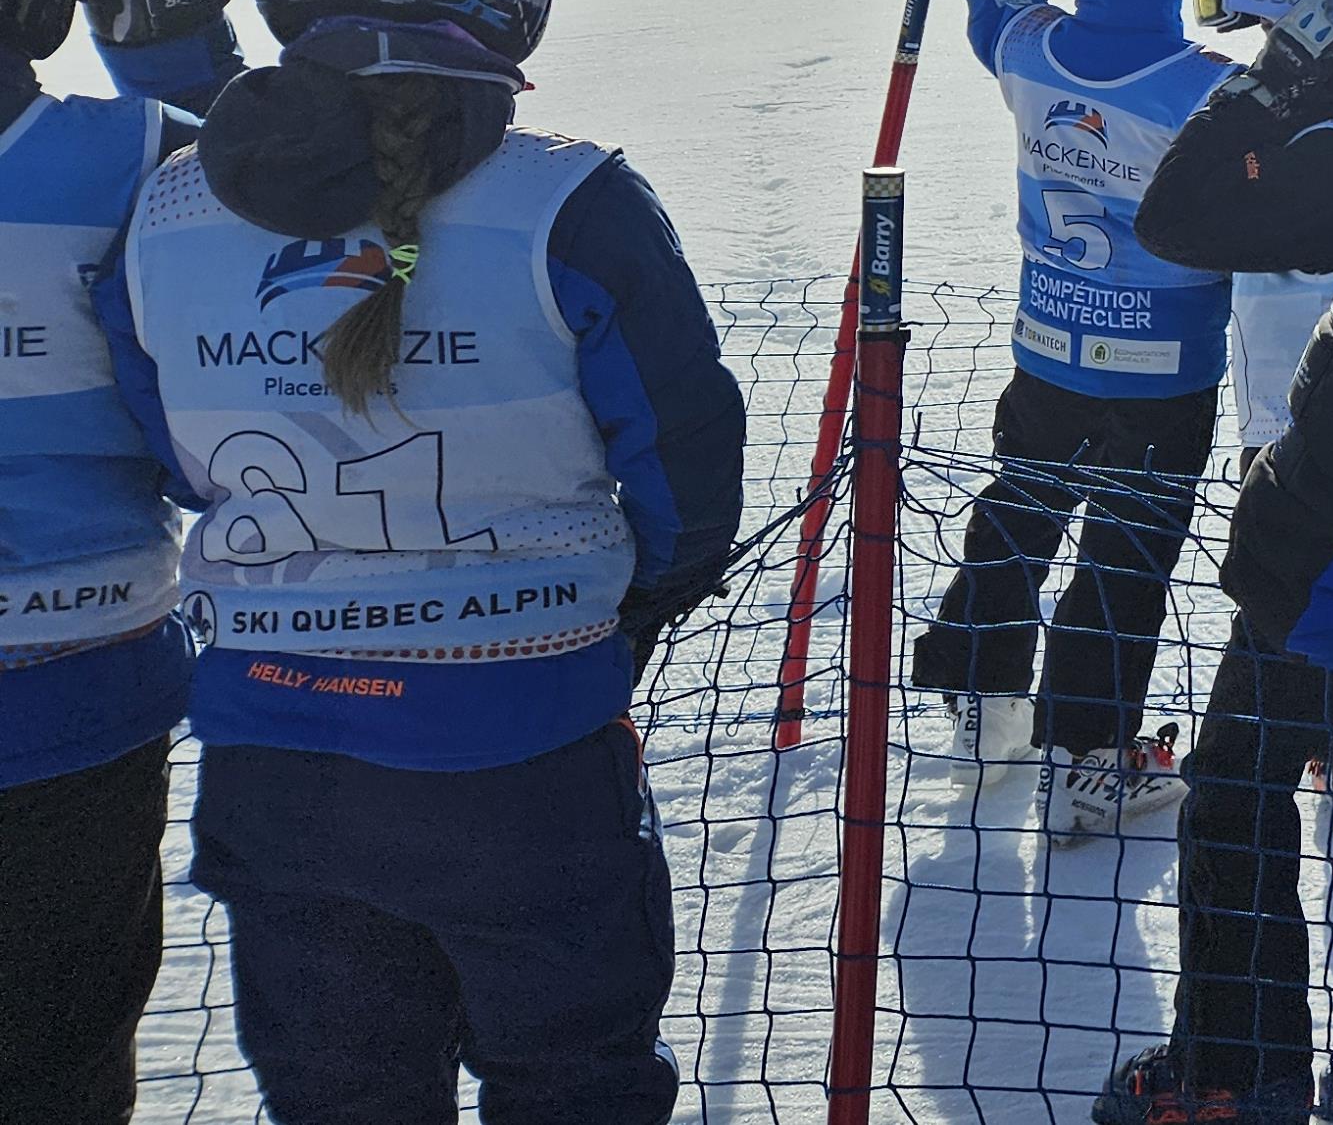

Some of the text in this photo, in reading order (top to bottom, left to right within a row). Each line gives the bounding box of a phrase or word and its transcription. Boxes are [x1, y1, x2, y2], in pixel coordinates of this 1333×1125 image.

[871, 213, 895, 276] Barry
[1041, 189, 1113, 271] 5
[1029, 289, 1152, 330] CHANTECLER
[1030, 270, 1152, 311] COMPÉTITION
[196, 330, 480, 367] MACKZIE
[22, 581, 134, 615] ALPIN
[232, 582, 579, 635] SKI QUÉBEC ALPIN
[247, 661, 404, 697] HELLY HANSEN
